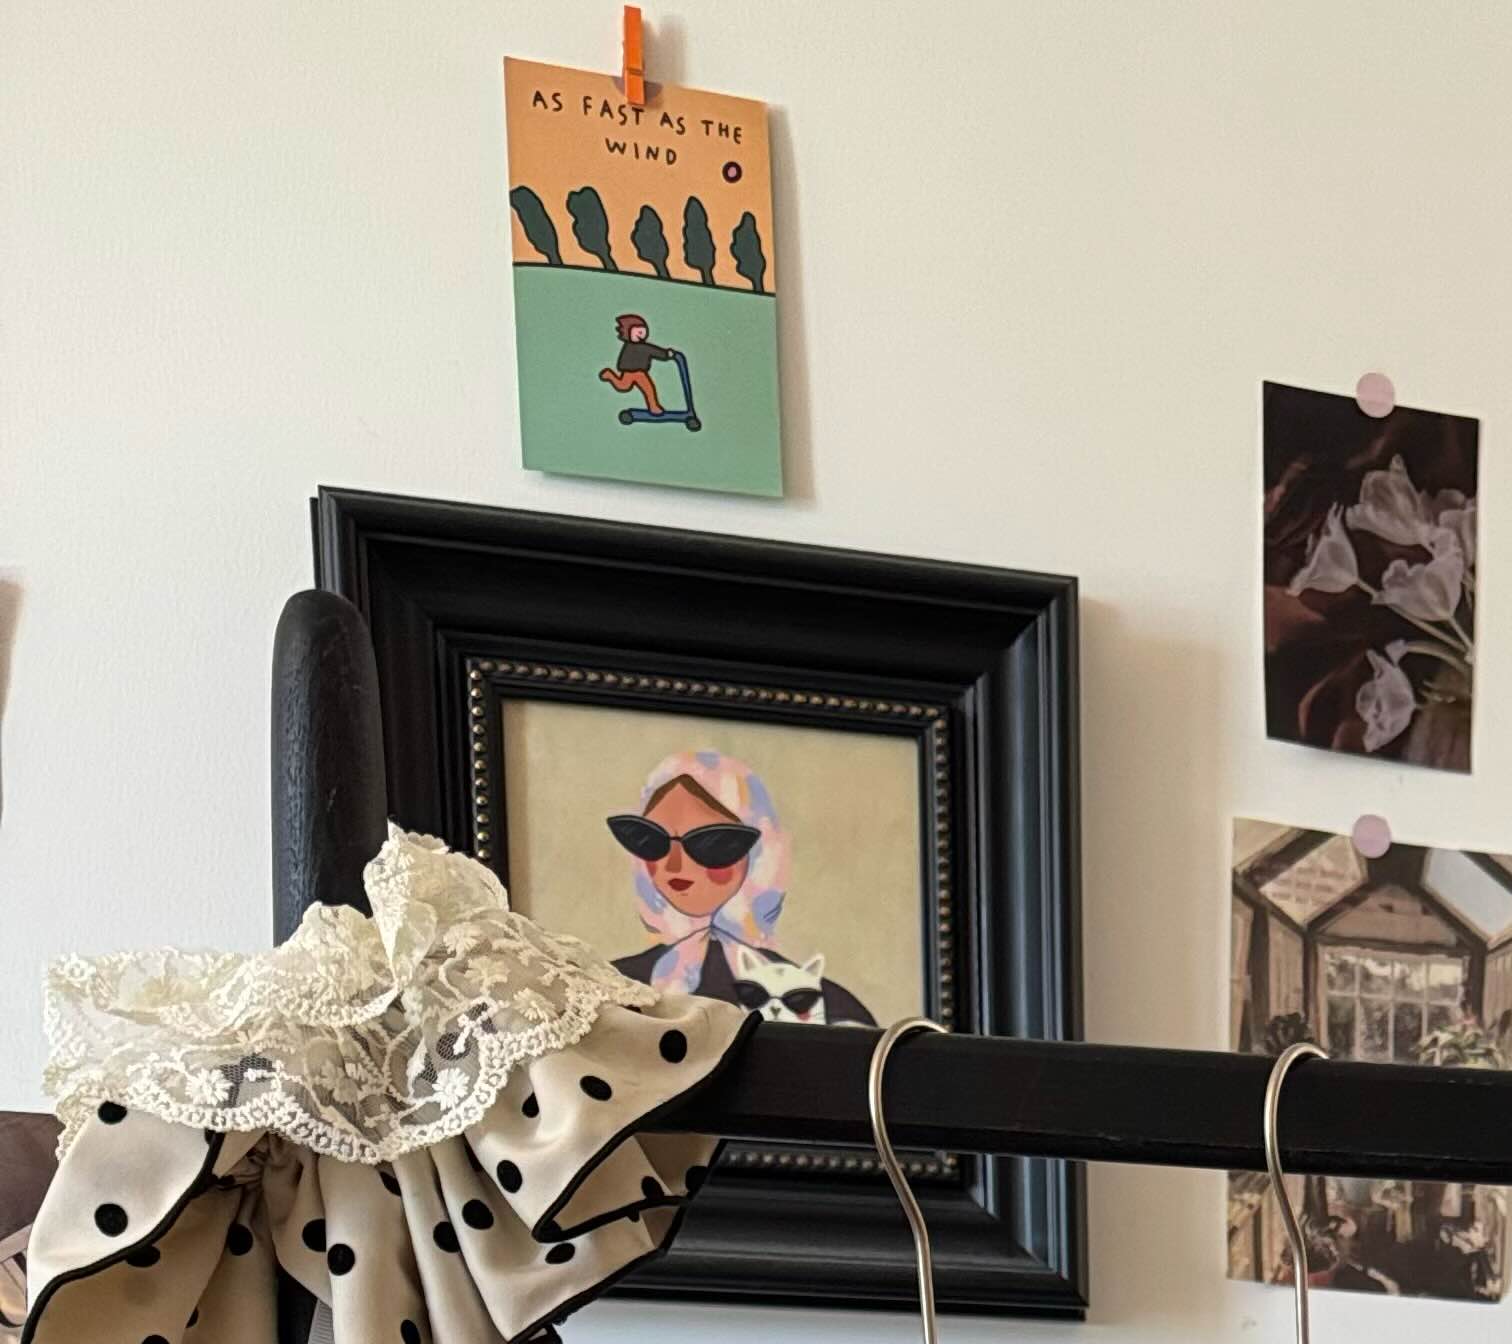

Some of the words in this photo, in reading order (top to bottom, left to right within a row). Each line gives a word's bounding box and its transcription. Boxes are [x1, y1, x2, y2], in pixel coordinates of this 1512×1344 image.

[532, 91, 563, 112] AS
[583, 96, 646, 126] FAST
[660, 113, 686, 135] AS
[701, 119, 743, 145] THE
[605, 138, 678, 165] WIND
